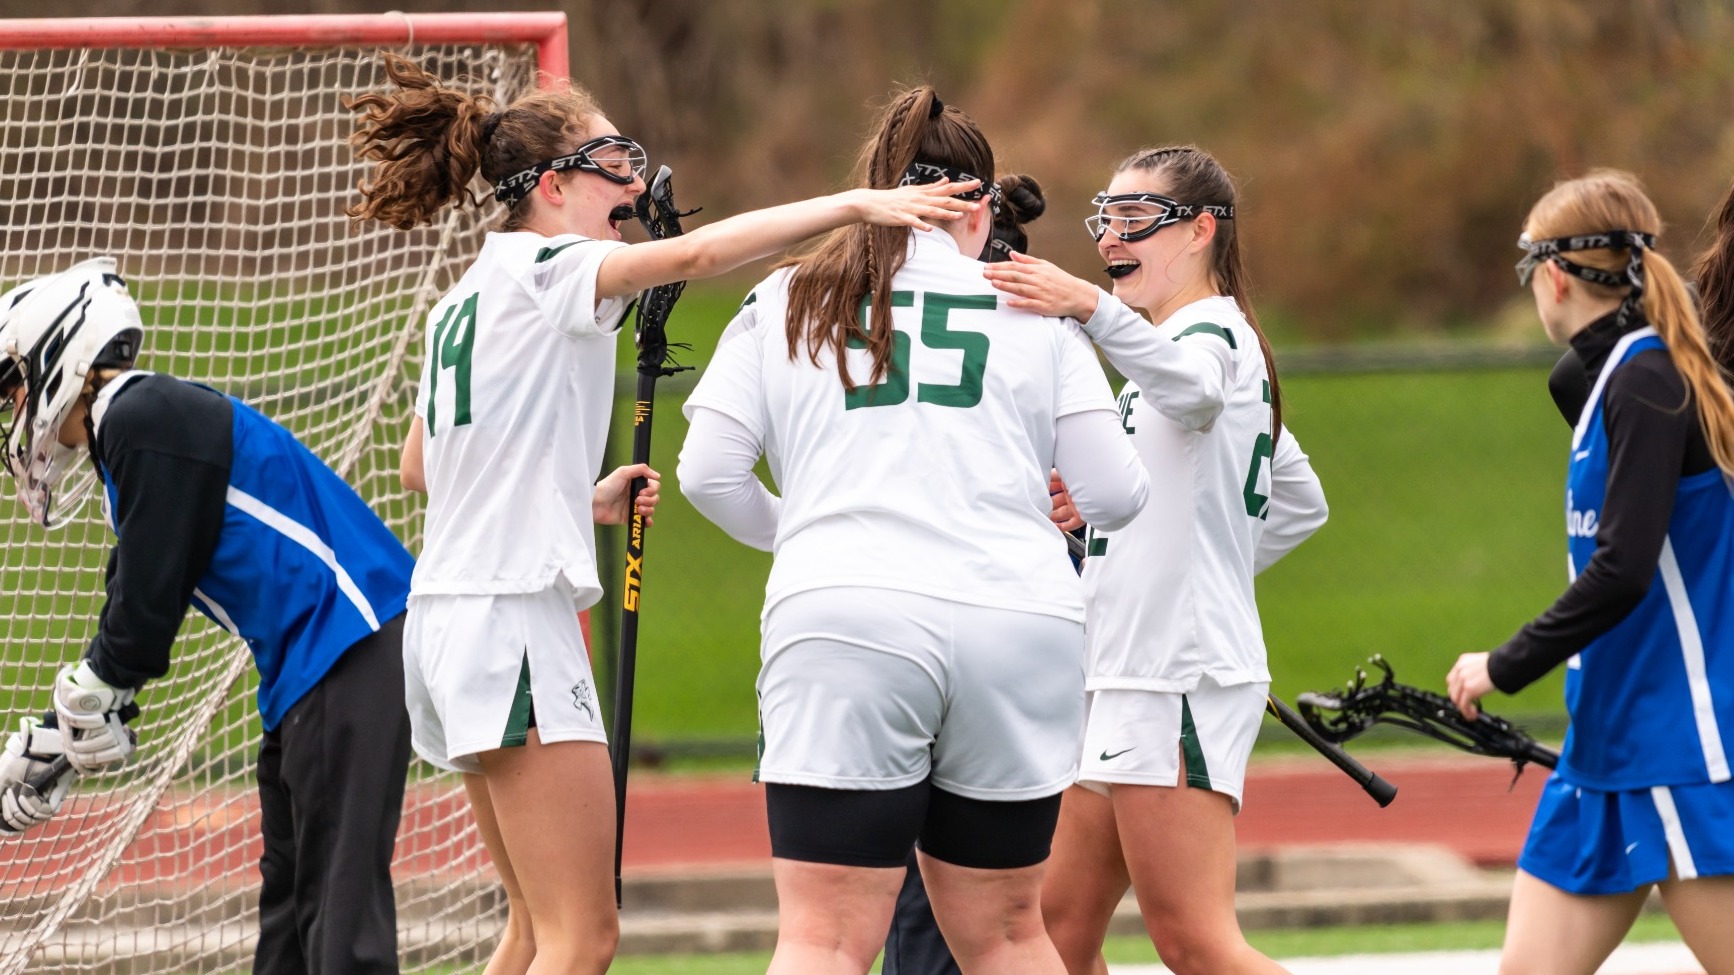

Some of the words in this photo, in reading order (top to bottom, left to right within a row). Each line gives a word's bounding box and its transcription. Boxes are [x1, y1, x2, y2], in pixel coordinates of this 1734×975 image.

[551, 154, 582, 170] ST
[1174, 204, 1194, 217] TX
[991, 238, 1014, 253] ST
[427, 291, 480, 439] 19
[845, 290, 998, 412] 55
[623, 551, 643, 613] STX
